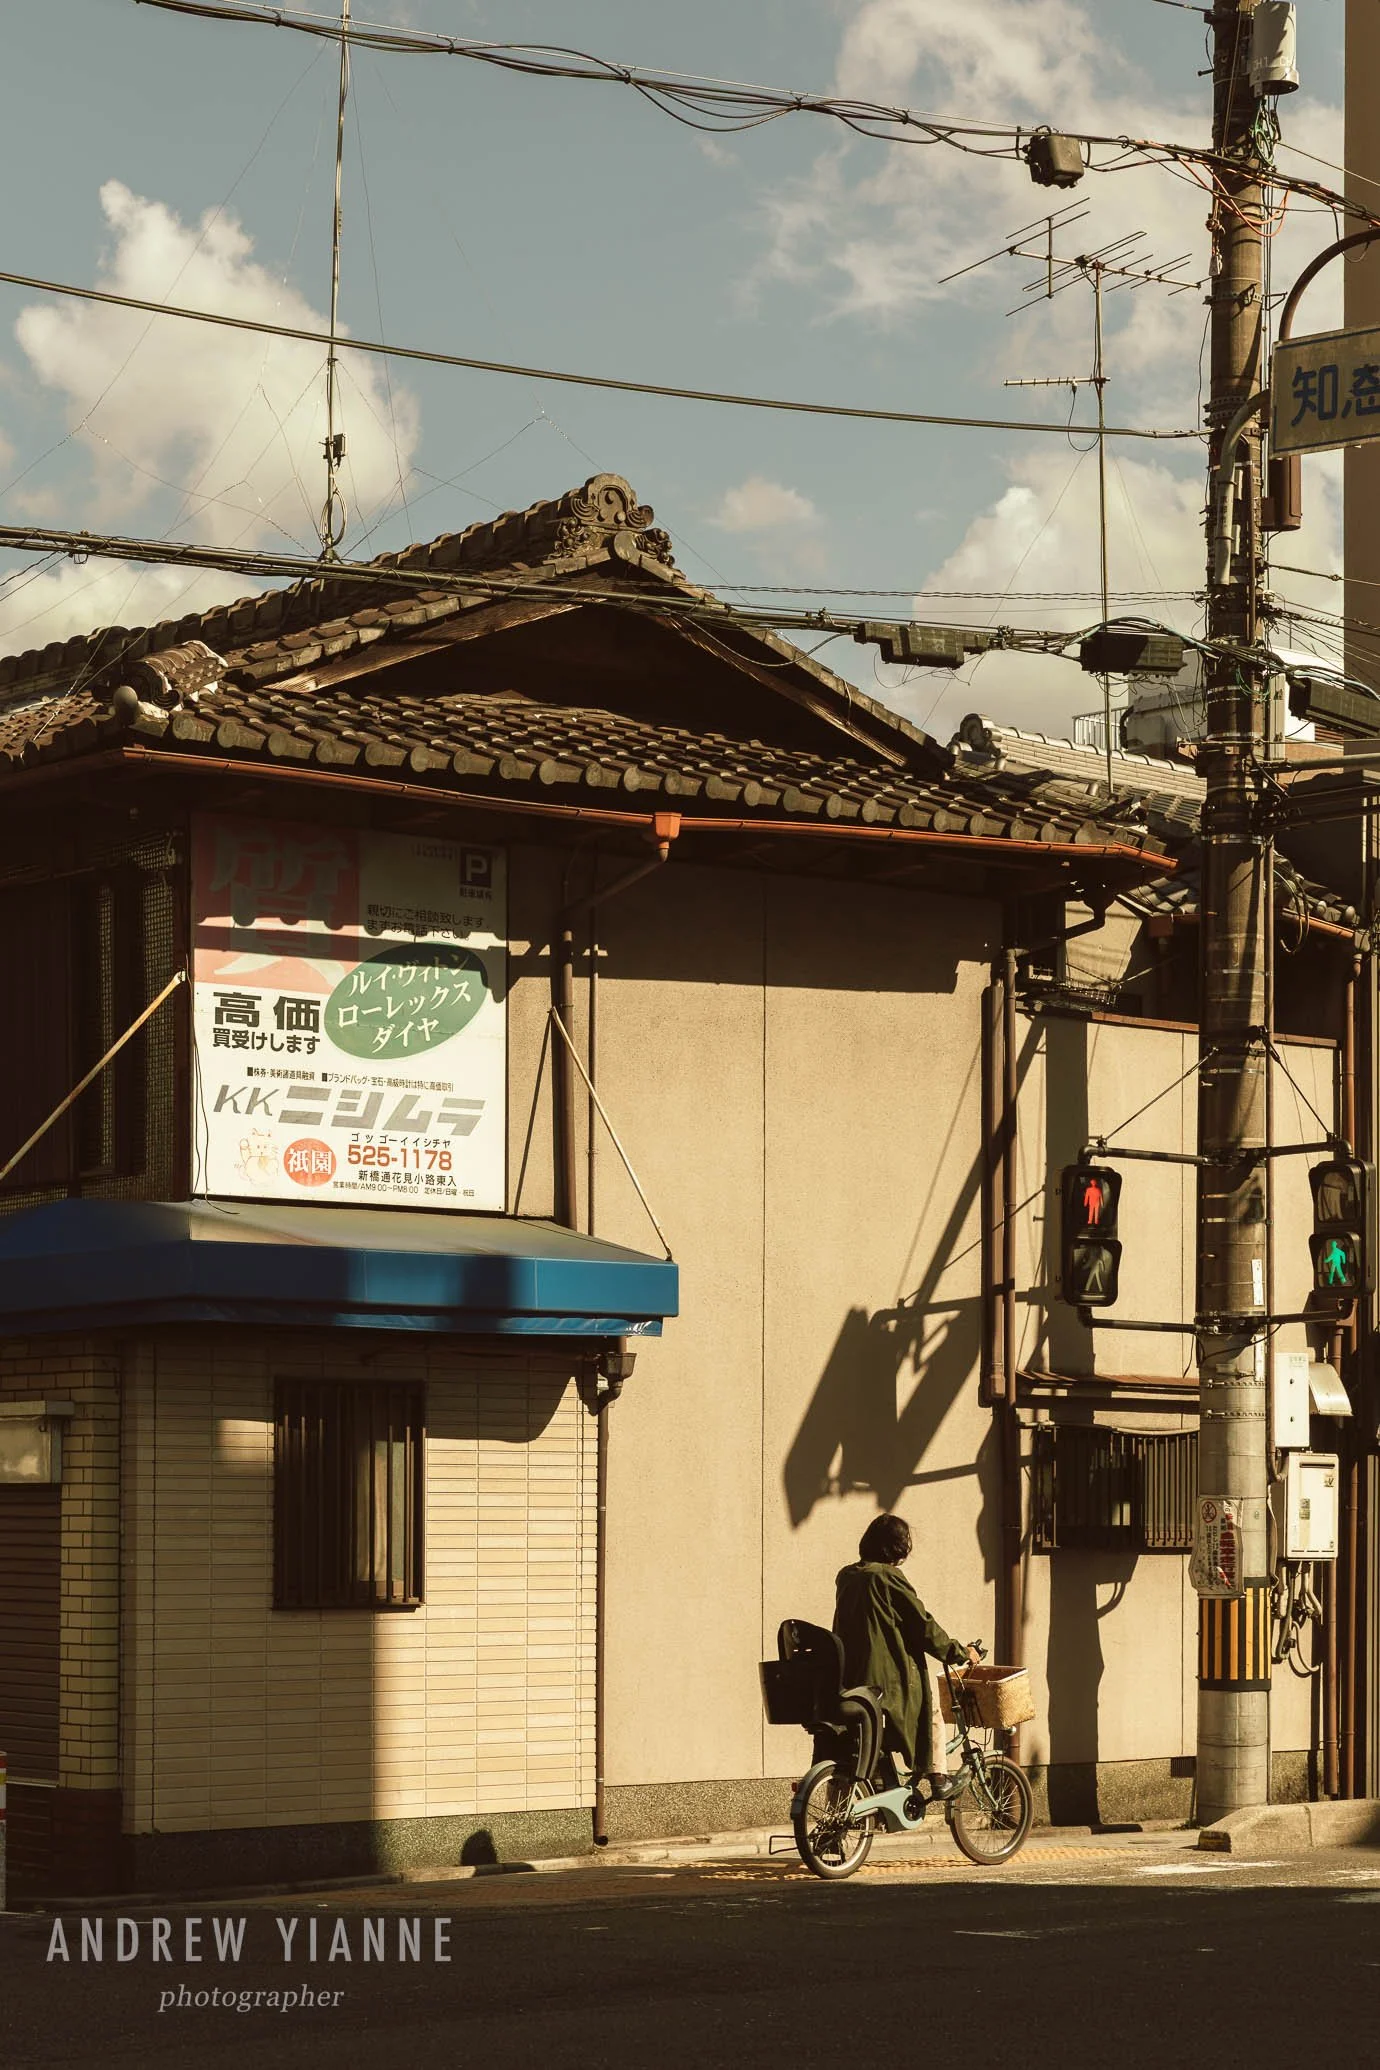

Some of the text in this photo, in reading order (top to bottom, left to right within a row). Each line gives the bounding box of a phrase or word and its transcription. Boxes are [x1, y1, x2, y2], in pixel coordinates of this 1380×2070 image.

[465, 854, 487, 882] P
[213, 992, 320, 1033] 高価
[338, 981, 471, 1028] ローレックス
[212, 1027, 320, 1055] 買受けします
[372, 1017, 439, 1053] ダイヤ
[213, 1084, 280, 1117] KK
[278, 1085, 486, 1137] ニシムラ
[348, 1144, 452, 1171] 525-1178
[358, 1169, 457, 1187] 新橋通花見小路東入
